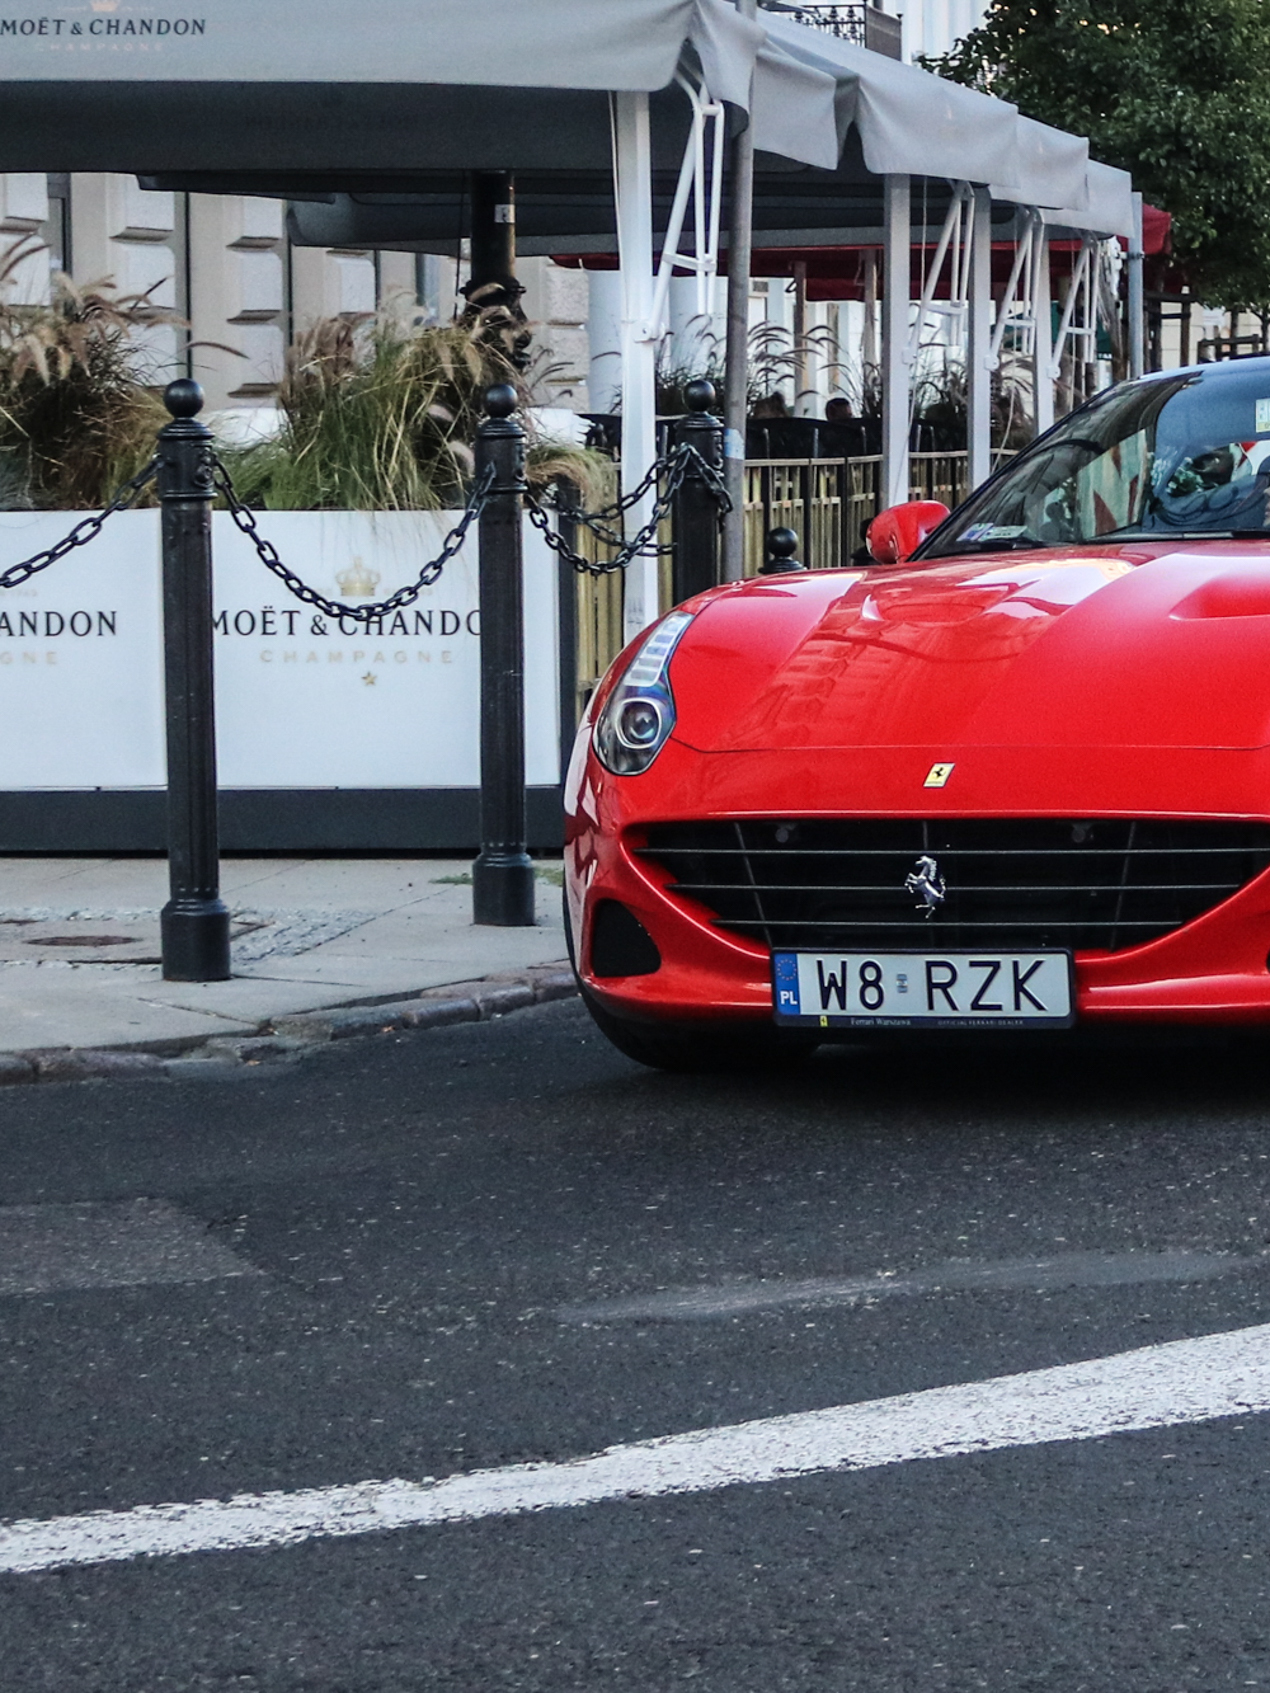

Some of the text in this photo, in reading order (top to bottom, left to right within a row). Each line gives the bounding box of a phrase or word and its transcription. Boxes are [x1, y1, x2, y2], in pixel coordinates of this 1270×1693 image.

[70, 23, 83, 36] &
[89, 18, 206, 36] CHANDON
[0, 610, 117, 637] ANDON
[310, 614, 329, 636] &
[338, 609, 481, 636] CHANDO
[259, 649, 454, 664] CHAMPAGNE
[816, 959, 1048, 1013] W8 RZK
[780, 990, 798, 1005] PL
